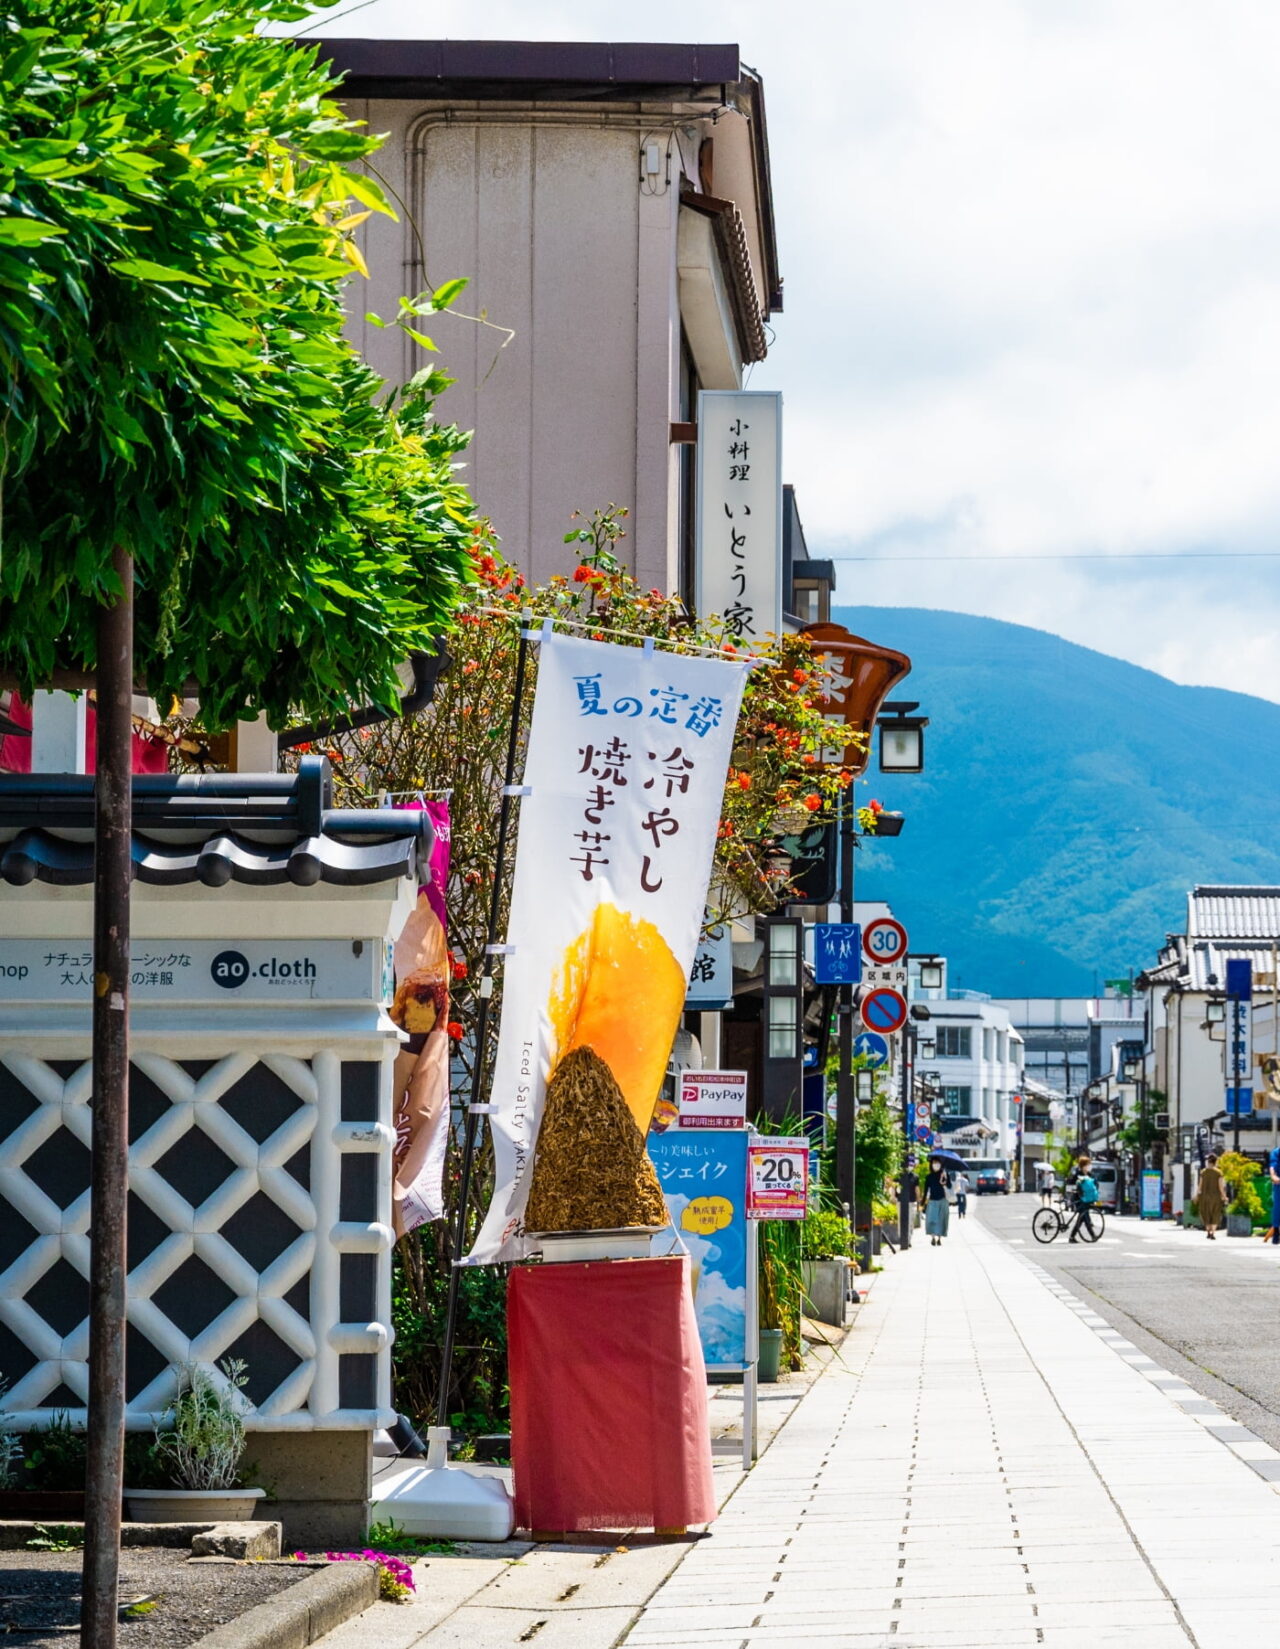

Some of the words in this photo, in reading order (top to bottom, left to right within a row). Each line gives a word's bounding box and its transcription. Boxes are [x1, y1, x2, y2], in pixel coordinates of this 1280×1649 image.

[728, 418, 750, 481] 小料理
[724, 503, 756, 636] いとう家
[573, 673, 723, 737] 夏の定番
[569, 736, 631, 881] 焼き芋
[640, 747, 694, 893] 冷やし
[873, 931, 898, 951] 30
[43, 953, 191, 967] ナチュラーシックな
[60, 971, 174, 985] 大人の洋服
[868, 971, 905, 981] 区域内
[520, 1041, 533, 1076] Iced
[511, 1086, 531, 1129] Salty
[701, 1089, 744, 1101] PayPay
[682, 1117, 739, 1126] 御利用出来ます
[762, 1158, 802, 1182] 20%
